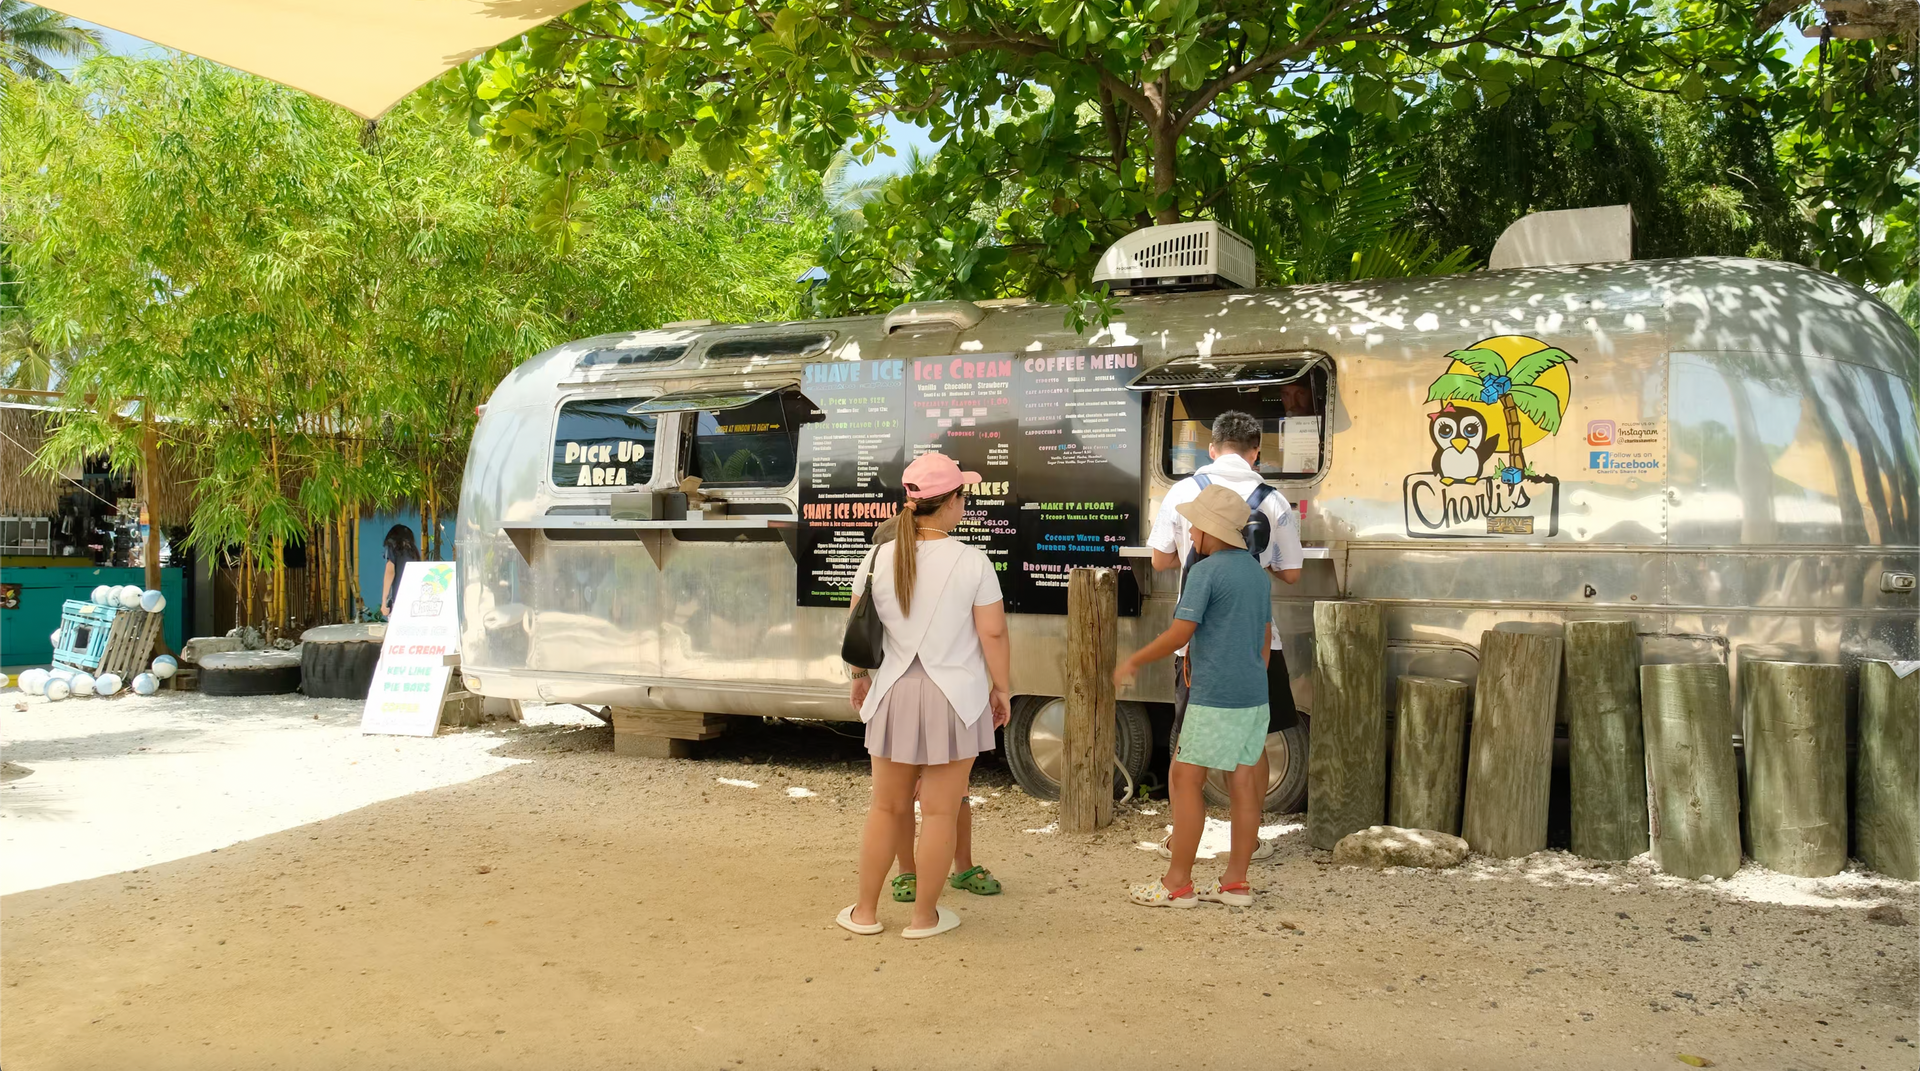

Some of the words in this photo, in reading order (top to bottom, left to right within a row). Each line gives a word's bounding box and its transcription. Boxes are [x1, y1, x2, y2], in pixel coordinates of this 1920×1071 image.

[1024, 355, 1086, 373] COFFEE
[1090, 353, 1138, 370] MENU
[805, 362, 860, 384] SHAVE
[871, 360, 904, 381] ICE
[944, 382, 973, 391] Chocolate
[977, 381, 1009, 390] Strawberry
[729, 424, 734, 433] AT
[734, 424, 751, 433] WINDOW
[752, 424, 757, 432] TO
[758, 423, 770, 432] RIGHT
[815, 421, 831, 430] PICK
[832, 421, 849, 429] YOUR
[1617, 428, 1659, 438] Instagram
[1610, 459, 1659, 469] facebook
[976, 499, 1005, 507] Strawberry
[1041, 502, 1063, 510] MAKE
[1066, 502, 1075, 510] IT
[1077, 502, 1083, 510] A
[1085, 502, 1114, 510] FLOAT!
[1411, 477, 1531, 530] Charli's
[803, 503, 832, 519] SHAVE
[834, 503, 850, 519] ICE
[852, 502, 898, 519] SPECIALS
[1488, 517, 1532, 527] SHAVE
[1045, 573, 1062, 581] topped
[388, 645, 405, 655] ICE
[408, 645, 446, 655] CREAM
[387, 665, 406, 675] KEY
[408, 666, 432, 675] LIME
[384, 682, 400, 692] PIE
[403, 682, 430, 692] BARS
